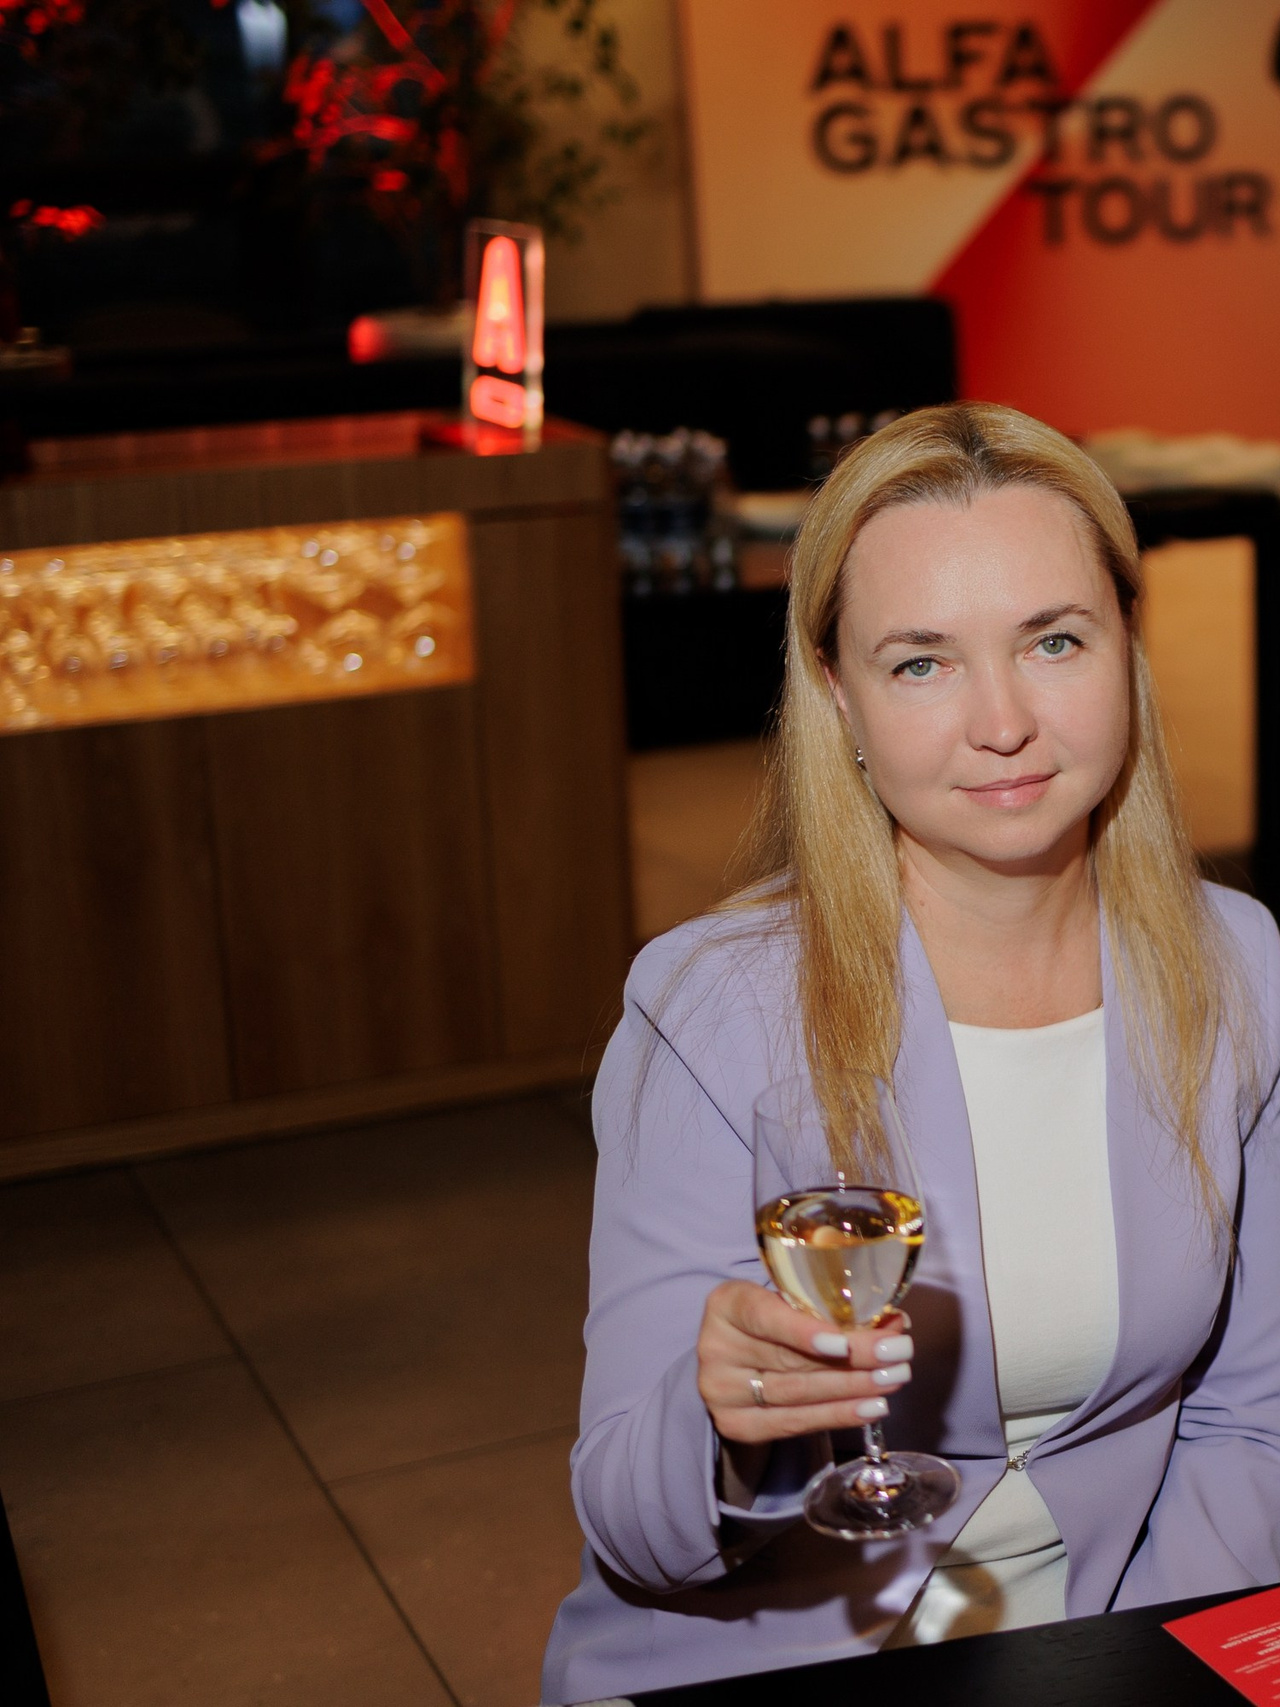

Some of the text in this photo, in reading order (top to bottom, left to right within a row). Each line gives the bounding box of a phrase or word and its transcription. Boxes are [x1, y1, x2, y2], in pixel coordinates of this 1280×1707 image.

[812, 20, 1058, 92] ALFA
[812, 93, 1218, 174] GASTRO
[1031, 171, 1274, 247] TOUR
